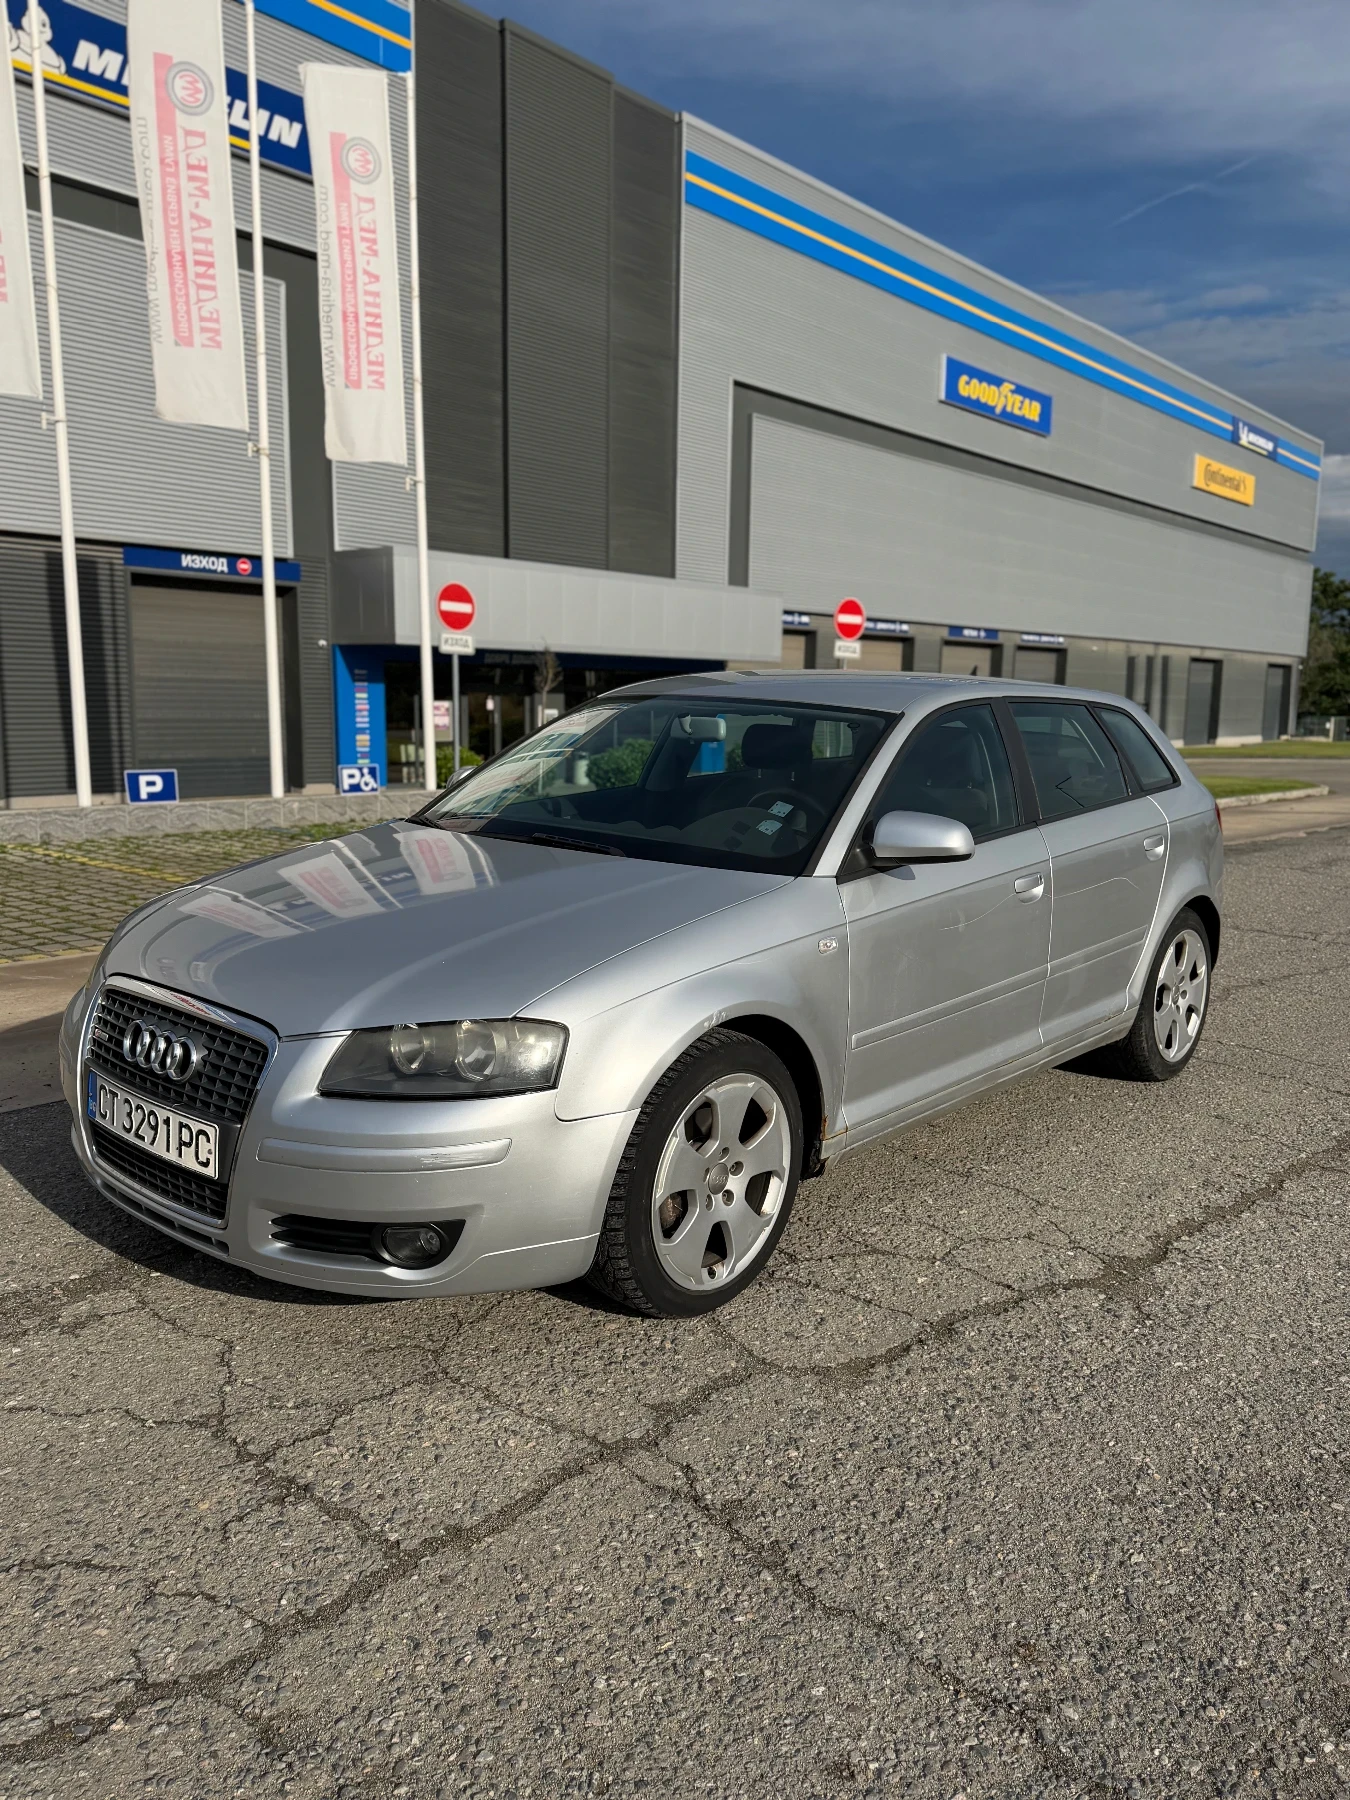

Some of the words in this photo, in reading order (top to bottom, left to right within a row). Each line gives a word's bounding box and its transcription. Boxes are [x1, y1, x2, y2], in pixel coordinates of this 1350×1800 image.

[958, 375, 1041, 423] GOODYEAR
[181, 554, 229, 573] ИЗХОД
[139, 775, 164, 799] P
[342, 768, 361, 790] P
[99, 1084, 120, 1127] CT
[122, 1097, 173, 1153] 3291
[177, 1121, 212, 1168] PC
